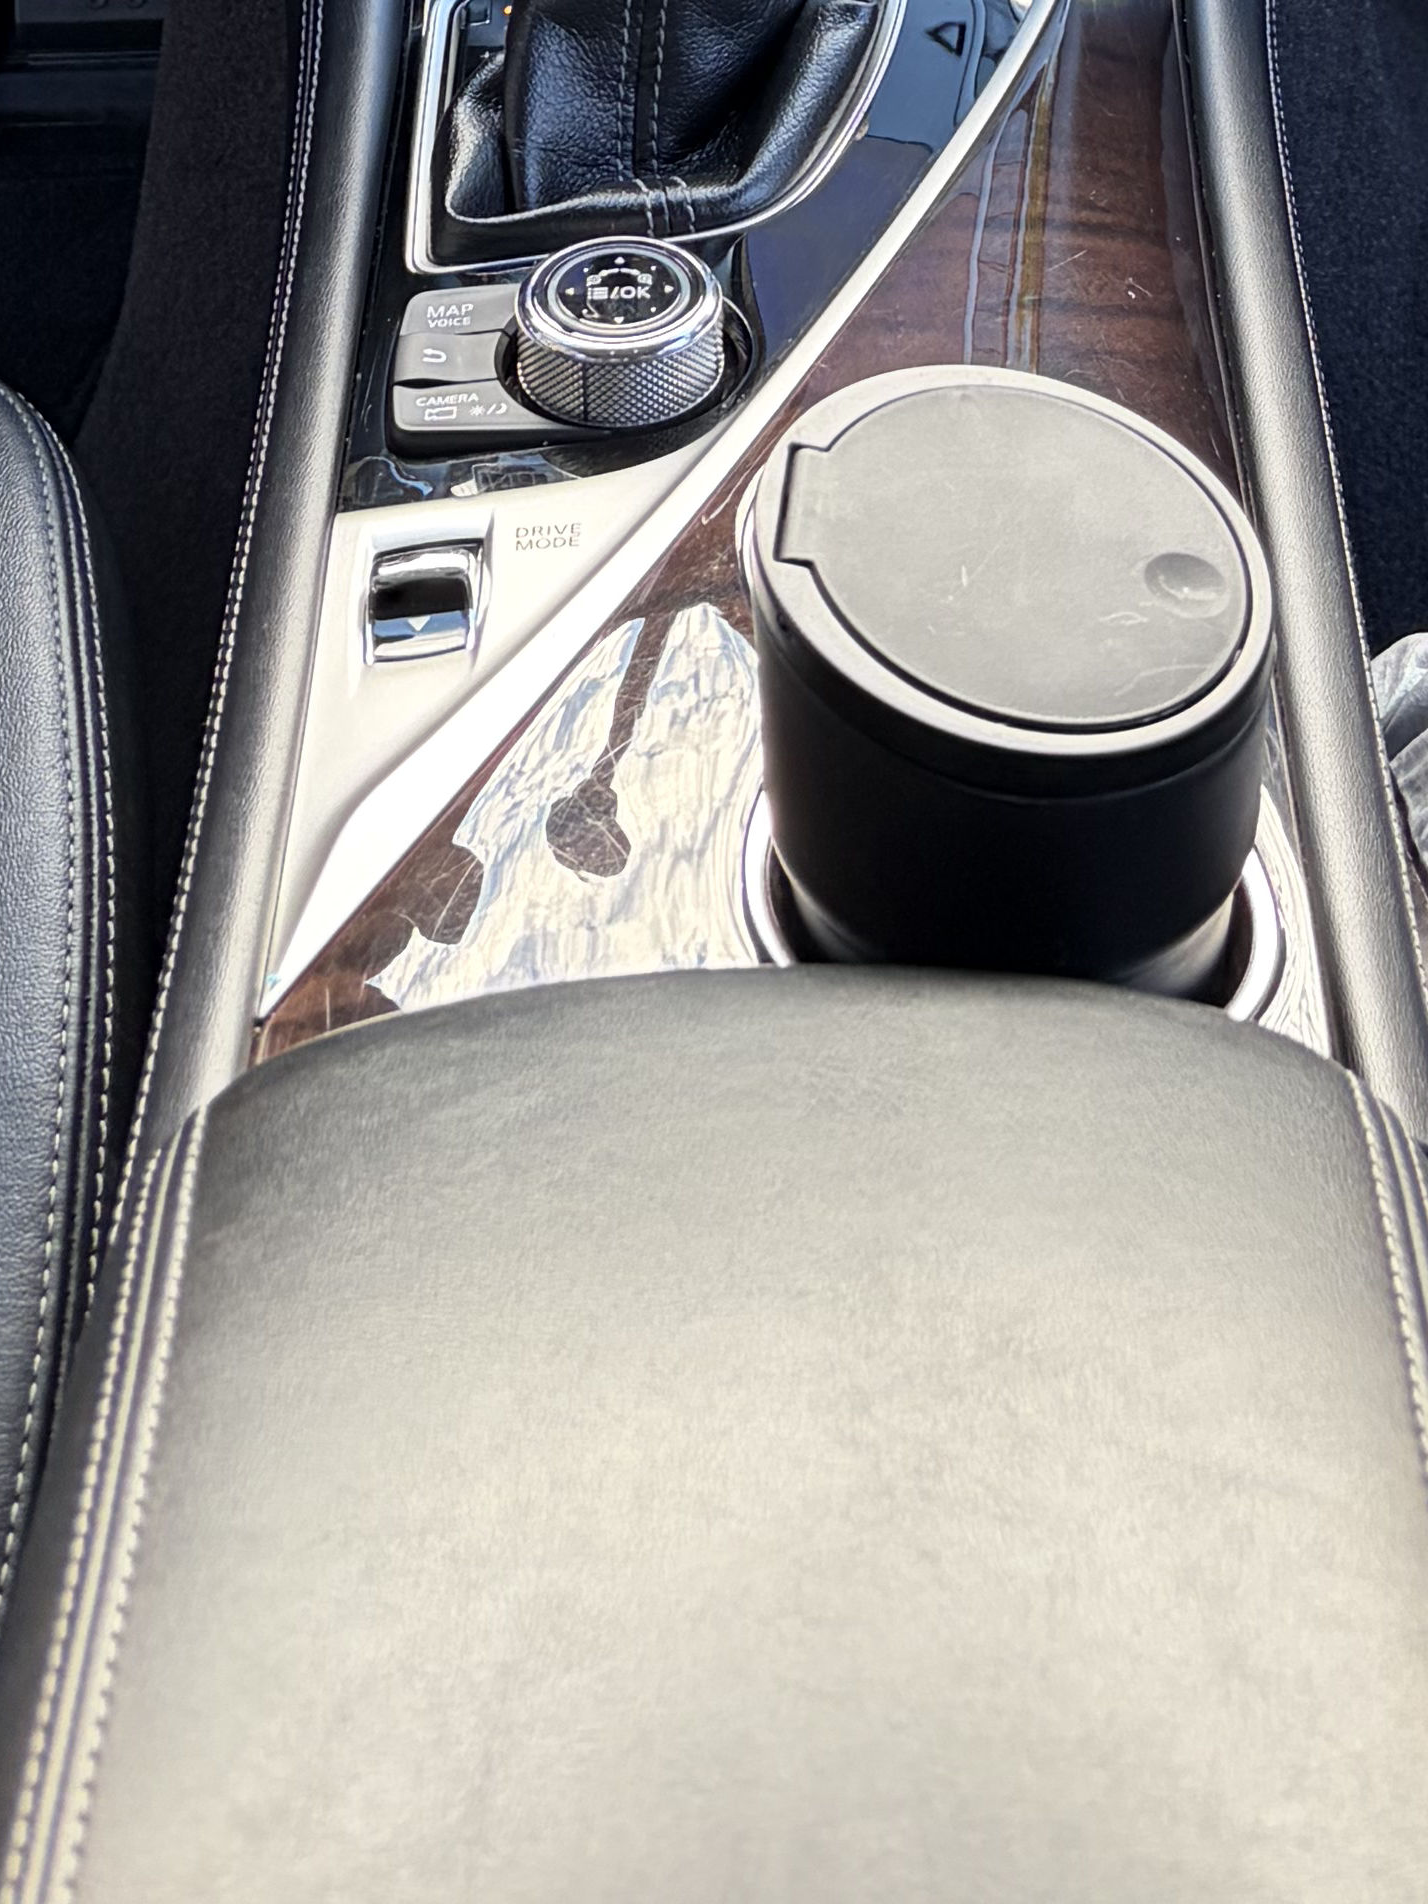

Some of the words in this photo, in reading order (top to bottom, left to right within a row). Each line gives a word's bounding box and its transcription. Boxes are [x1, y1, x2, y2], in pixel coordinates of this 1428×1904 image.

[426, 303, 474, 318] MAP
[427, 316, 471, 328] VOICE
[415, 392, 479, 407] CAMERA
[515, 523, 582, 539] DRIVE
[515, 536, 581, 551] MODE
